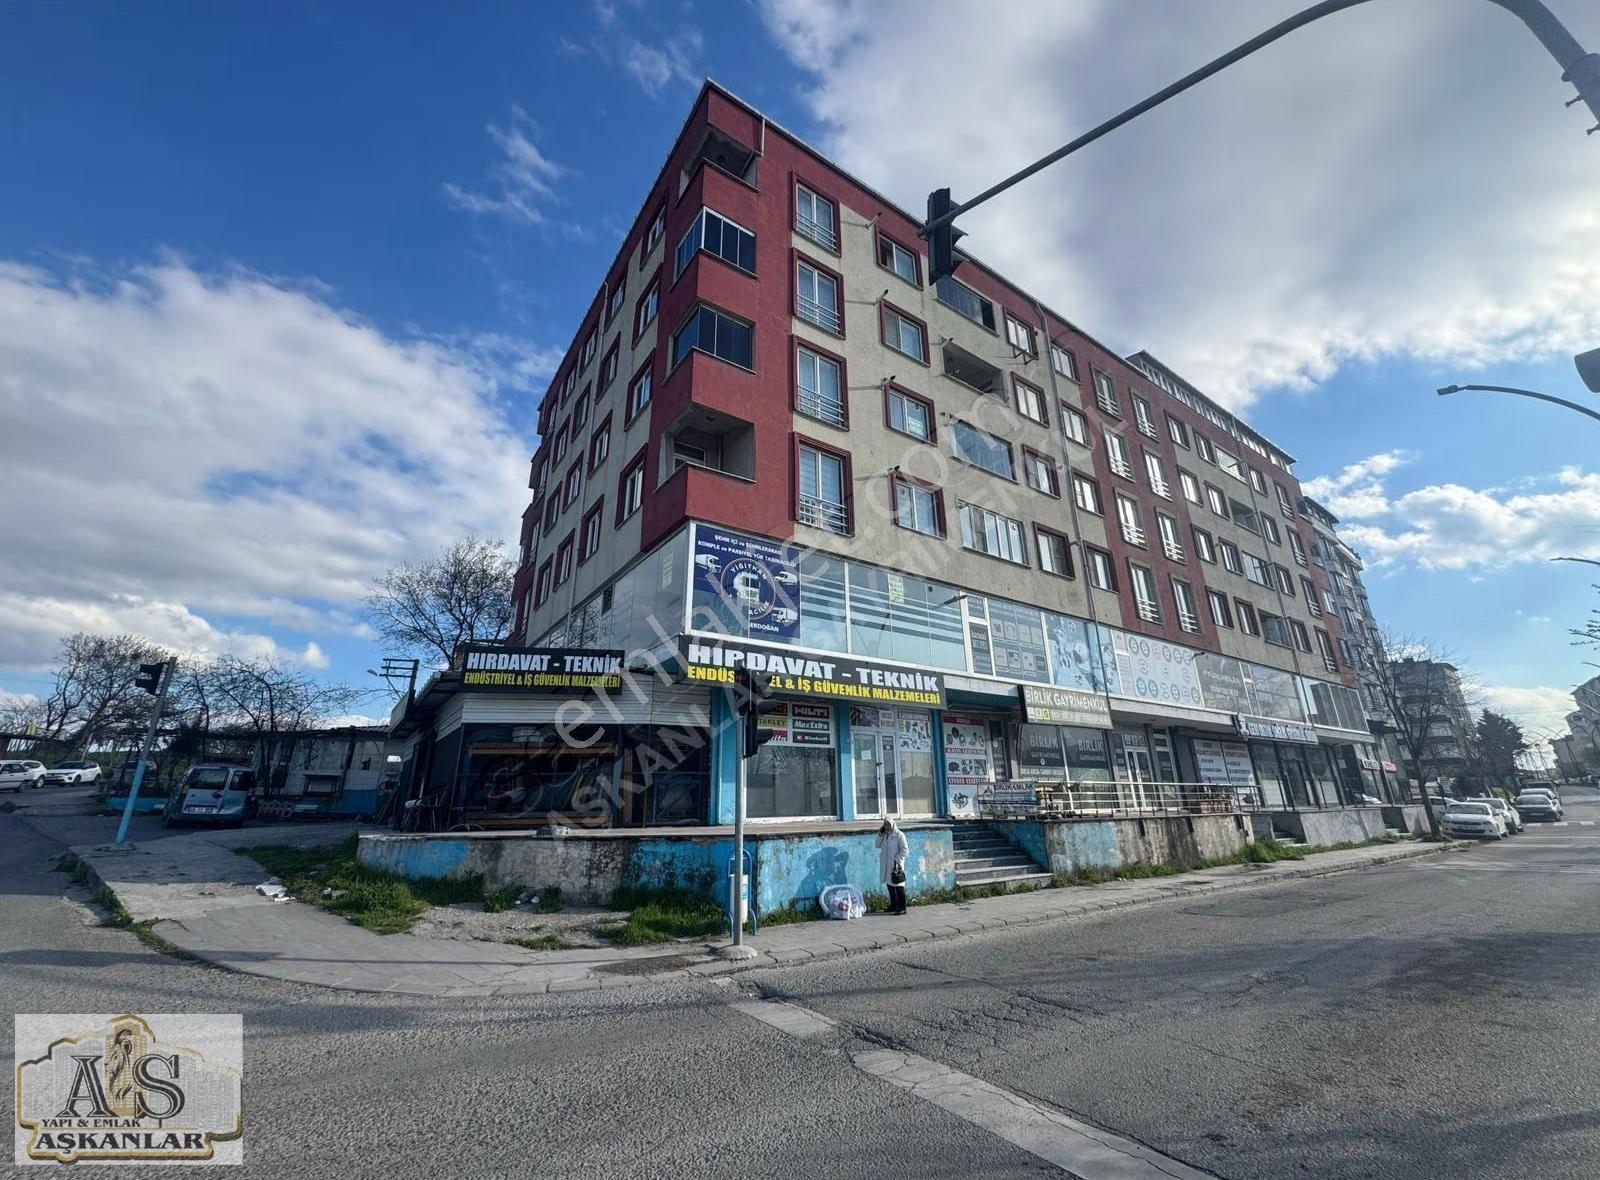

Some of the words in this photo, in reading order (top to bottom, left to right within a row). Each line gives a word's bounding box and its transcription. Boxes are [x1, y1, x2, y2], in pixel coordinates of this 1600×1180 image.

[698, 540, 720, 550] KOMPLE
[466, 652, 551, 671] HIRDAVAT
[563, 654, 622, 674] TEKNİK
[464, 671, 516, 686] ENDÜSTRİYEL
[516, 675, 523, 686] &
[524, 673, 533, 688] İŞ
[534, 673, 570, 687] GÜVENLİK
[571, 674, 621, 688] MALZEMELERİ
[687, 665, 782, 688] ENDÜSEL
[785, 678, 795, 690] &
[797, 676, 811, 693] İŞ
[813, 680, 871, 698] GÜVENLİK
[872, 688, 940, 704] MALZEMELERİ
[856, 667, 940, 692] TEKNİK
[1025, 687, 1052, 705] BİRLİK
[758, 718, 786, 726] TANLEY
